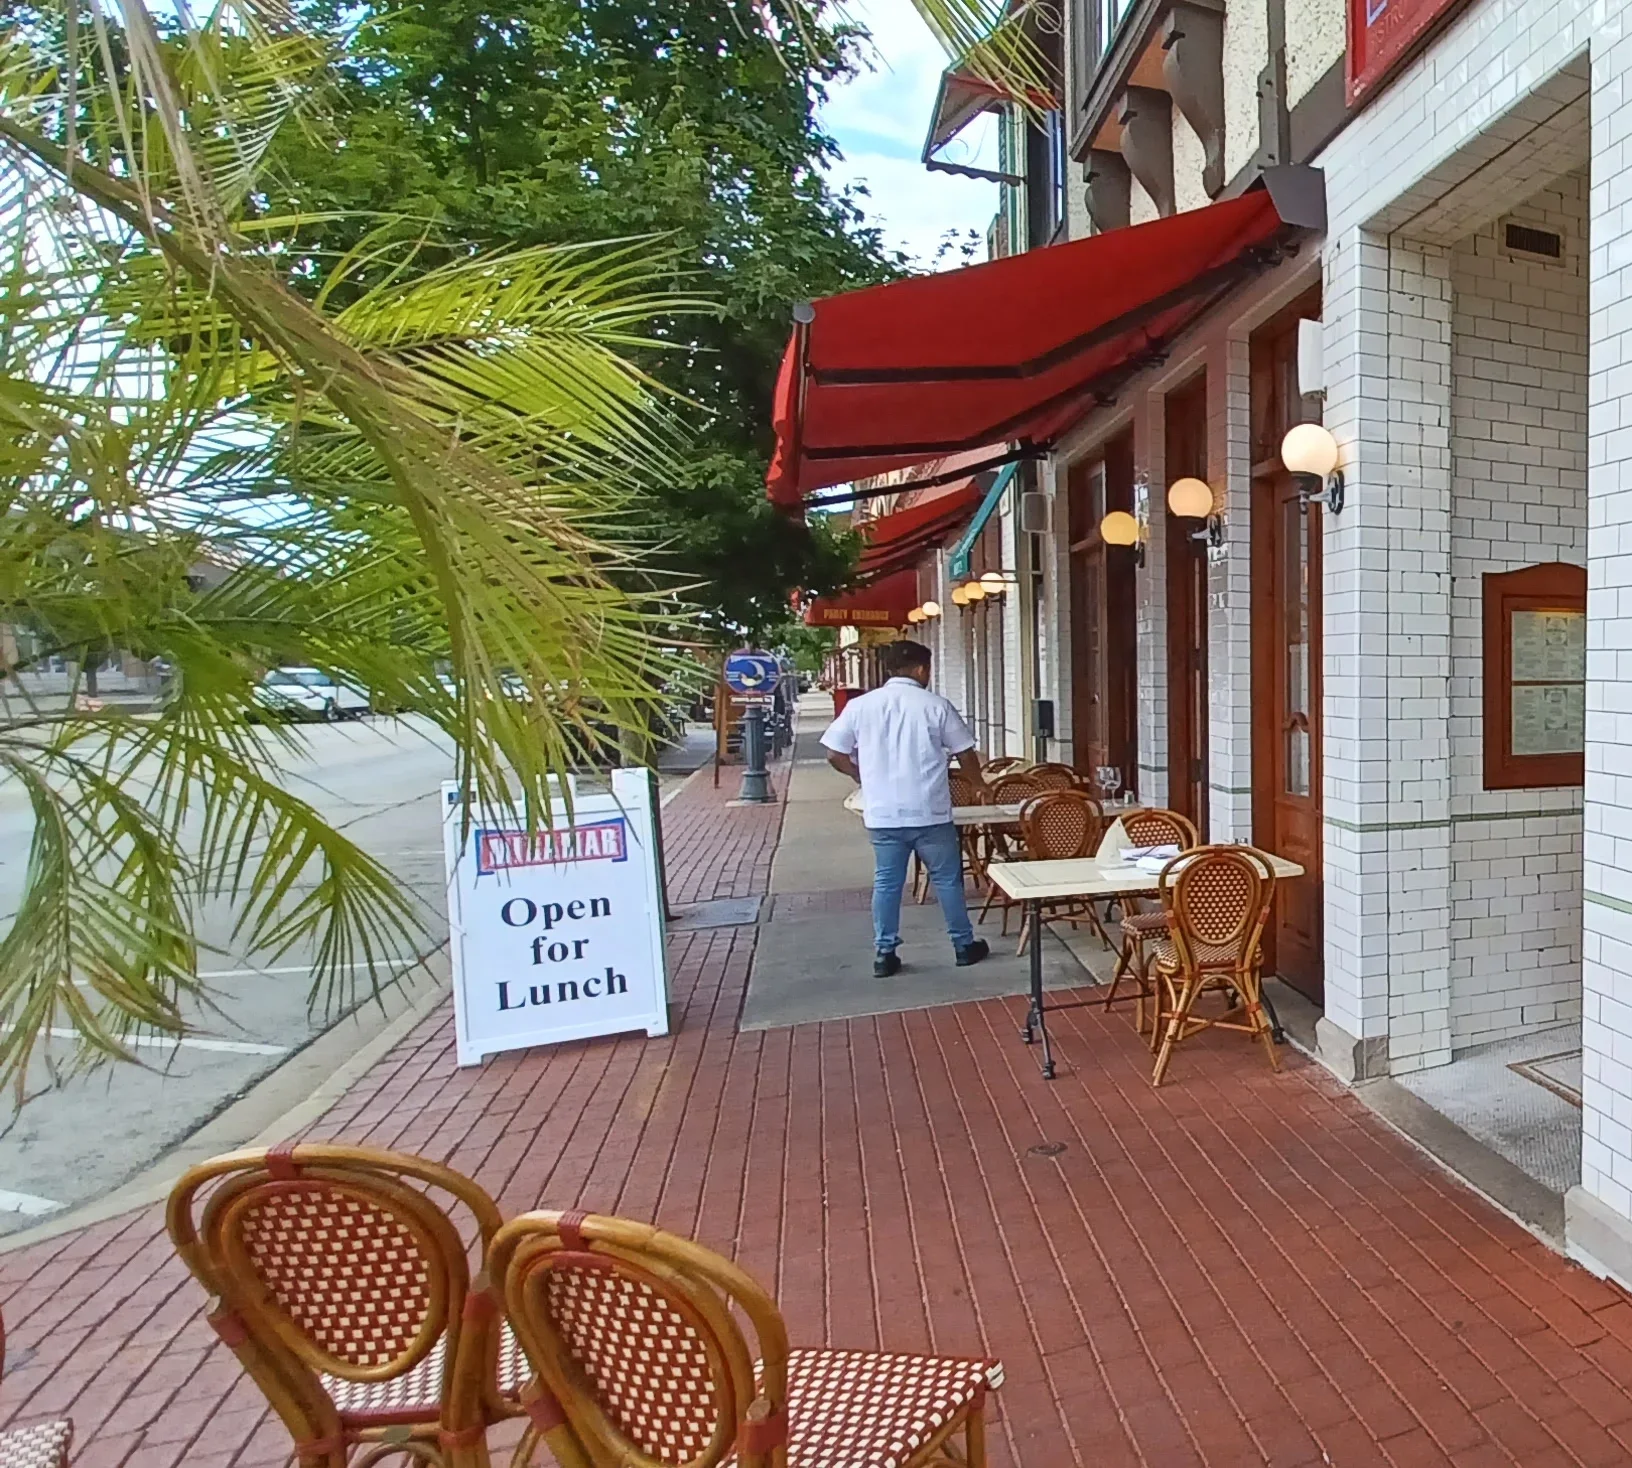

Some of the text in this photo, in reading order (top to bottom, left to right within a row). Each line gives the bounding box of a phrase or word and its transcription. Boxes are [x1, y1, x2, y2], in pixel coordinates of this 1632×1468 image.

[501, 897, 611, 930] Open
[530, 935, 589, 966] for
[495, 967, 628, 1012] Lunch
